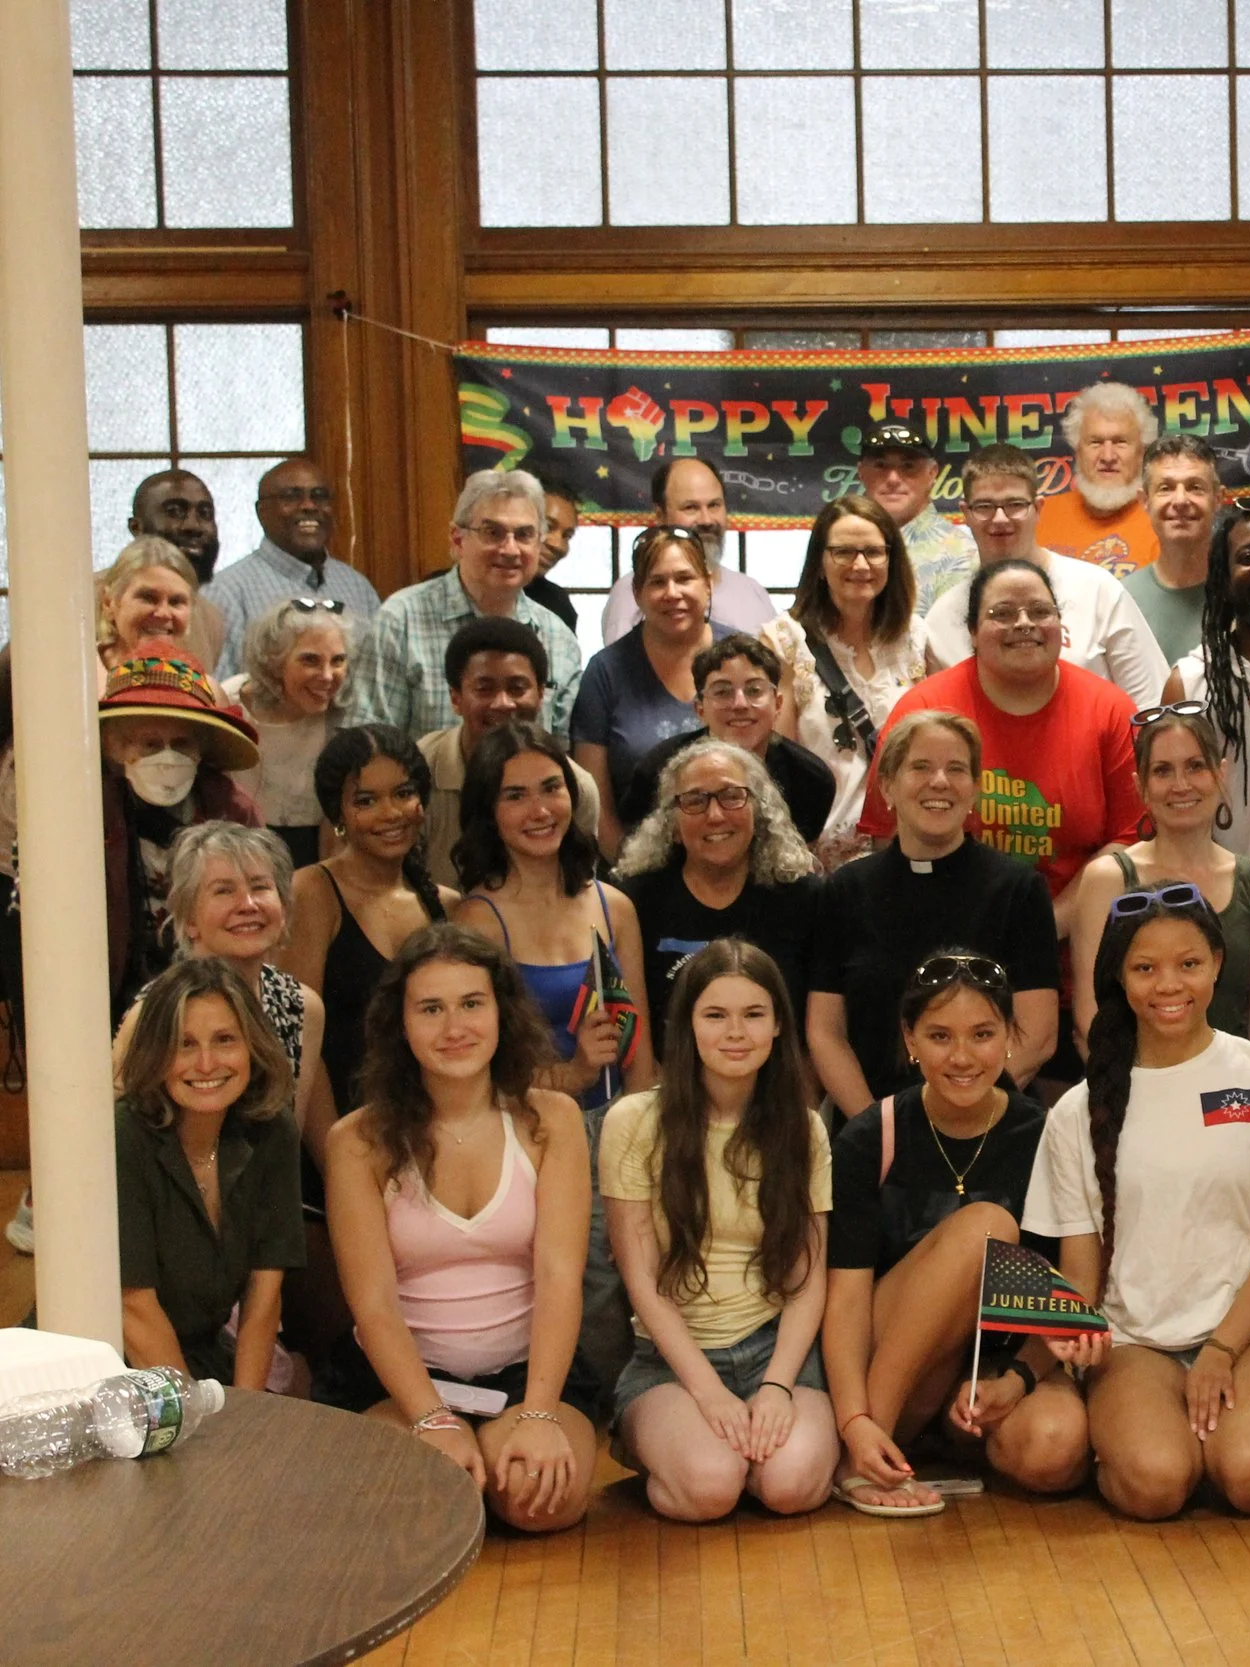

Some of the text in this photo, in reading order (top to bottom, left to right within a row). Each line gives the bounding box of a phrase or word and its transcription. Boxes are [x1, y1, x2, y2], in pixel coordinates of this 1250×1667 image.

[981, 769, 1026, 798] One
[981, 798, 1062, 828] United
[981, 829, 1054, 856] Africa
